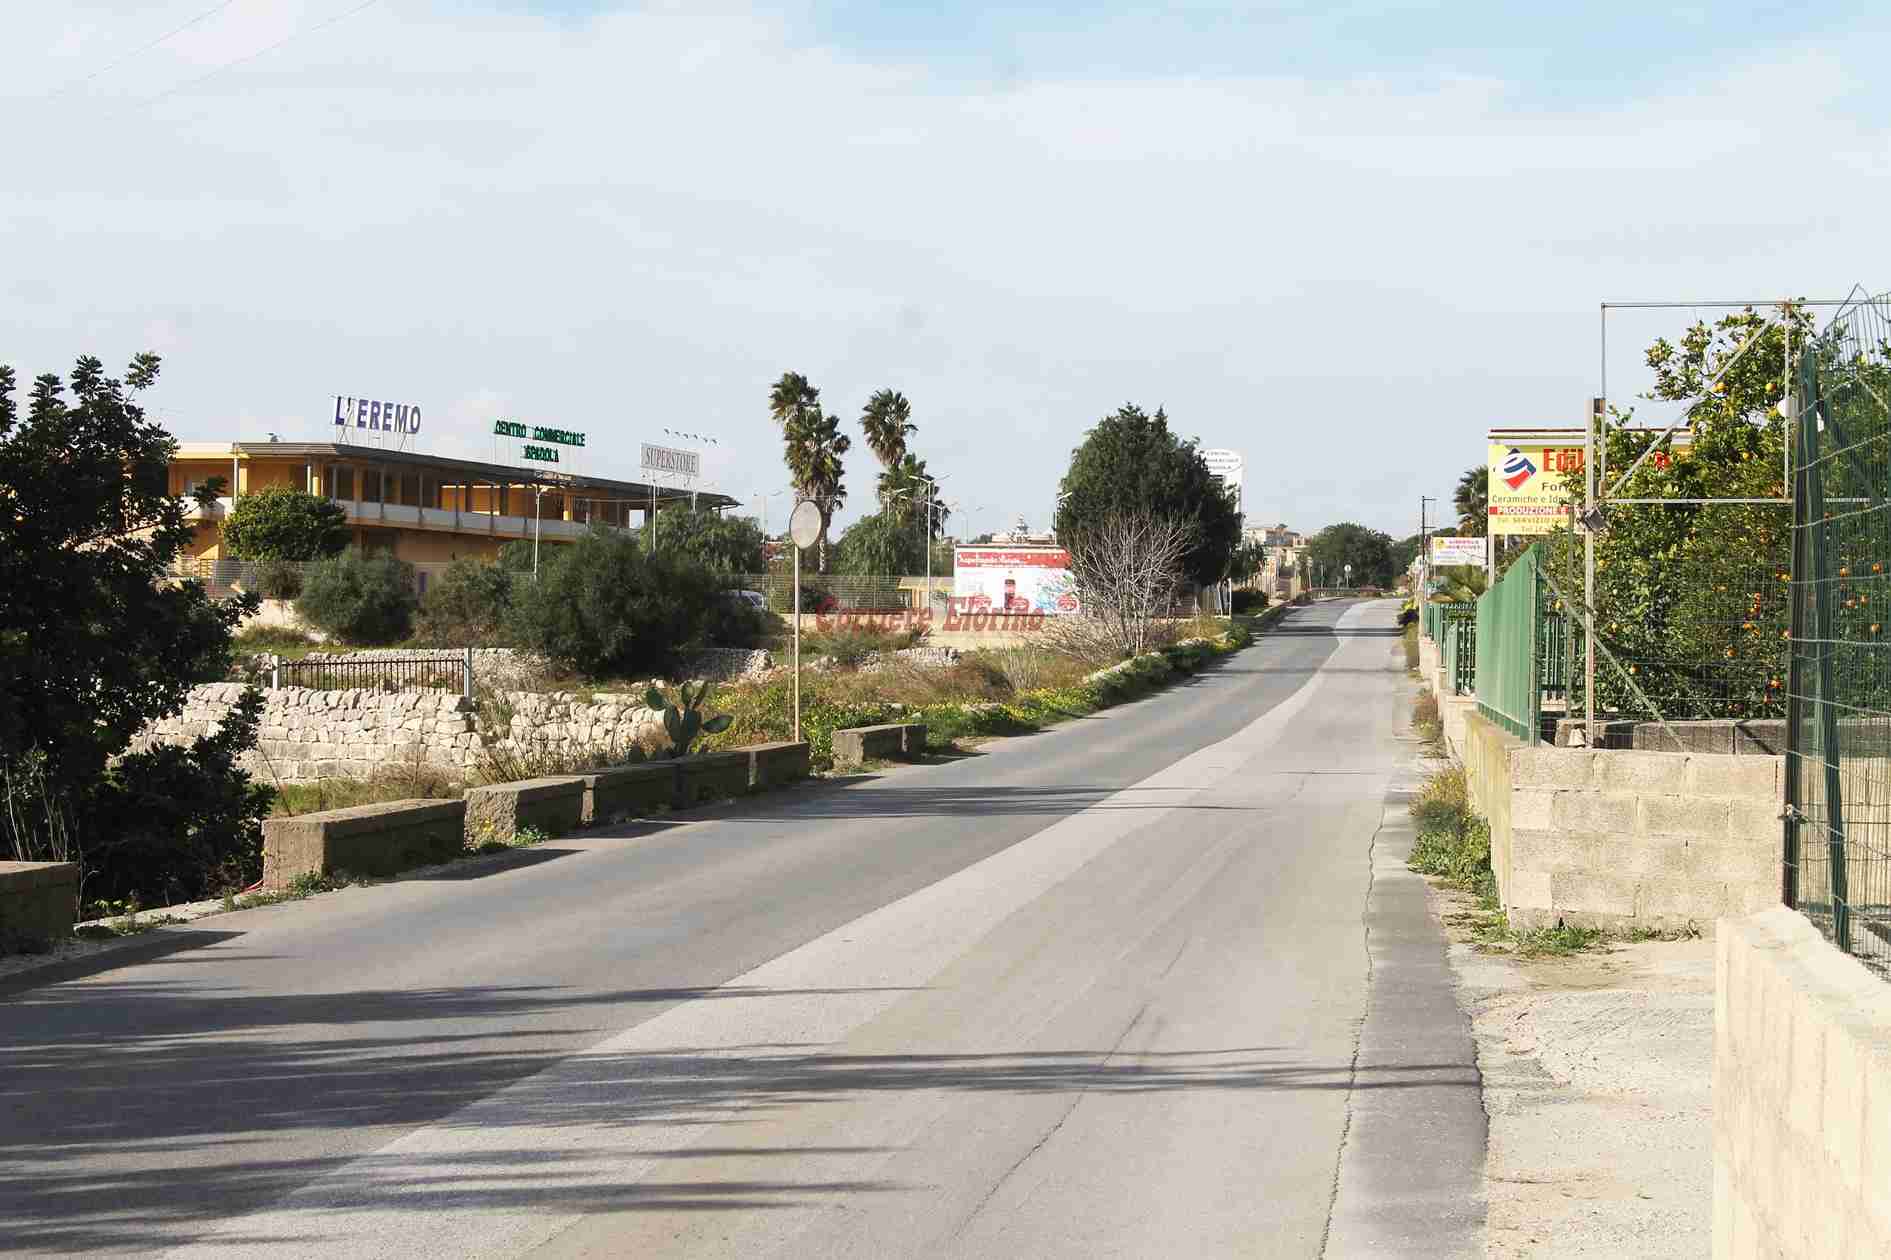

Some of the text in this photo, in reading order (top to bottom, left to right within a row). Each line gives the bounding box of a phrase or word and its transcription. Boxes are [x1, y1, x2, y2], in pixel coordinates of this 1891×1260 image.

[335, 395, 421, 434] L'EREMO
[495, 420, 586, 447] CENTRO COMMERCIALE
[645, 447, 697, 473] SUPERSTORE
